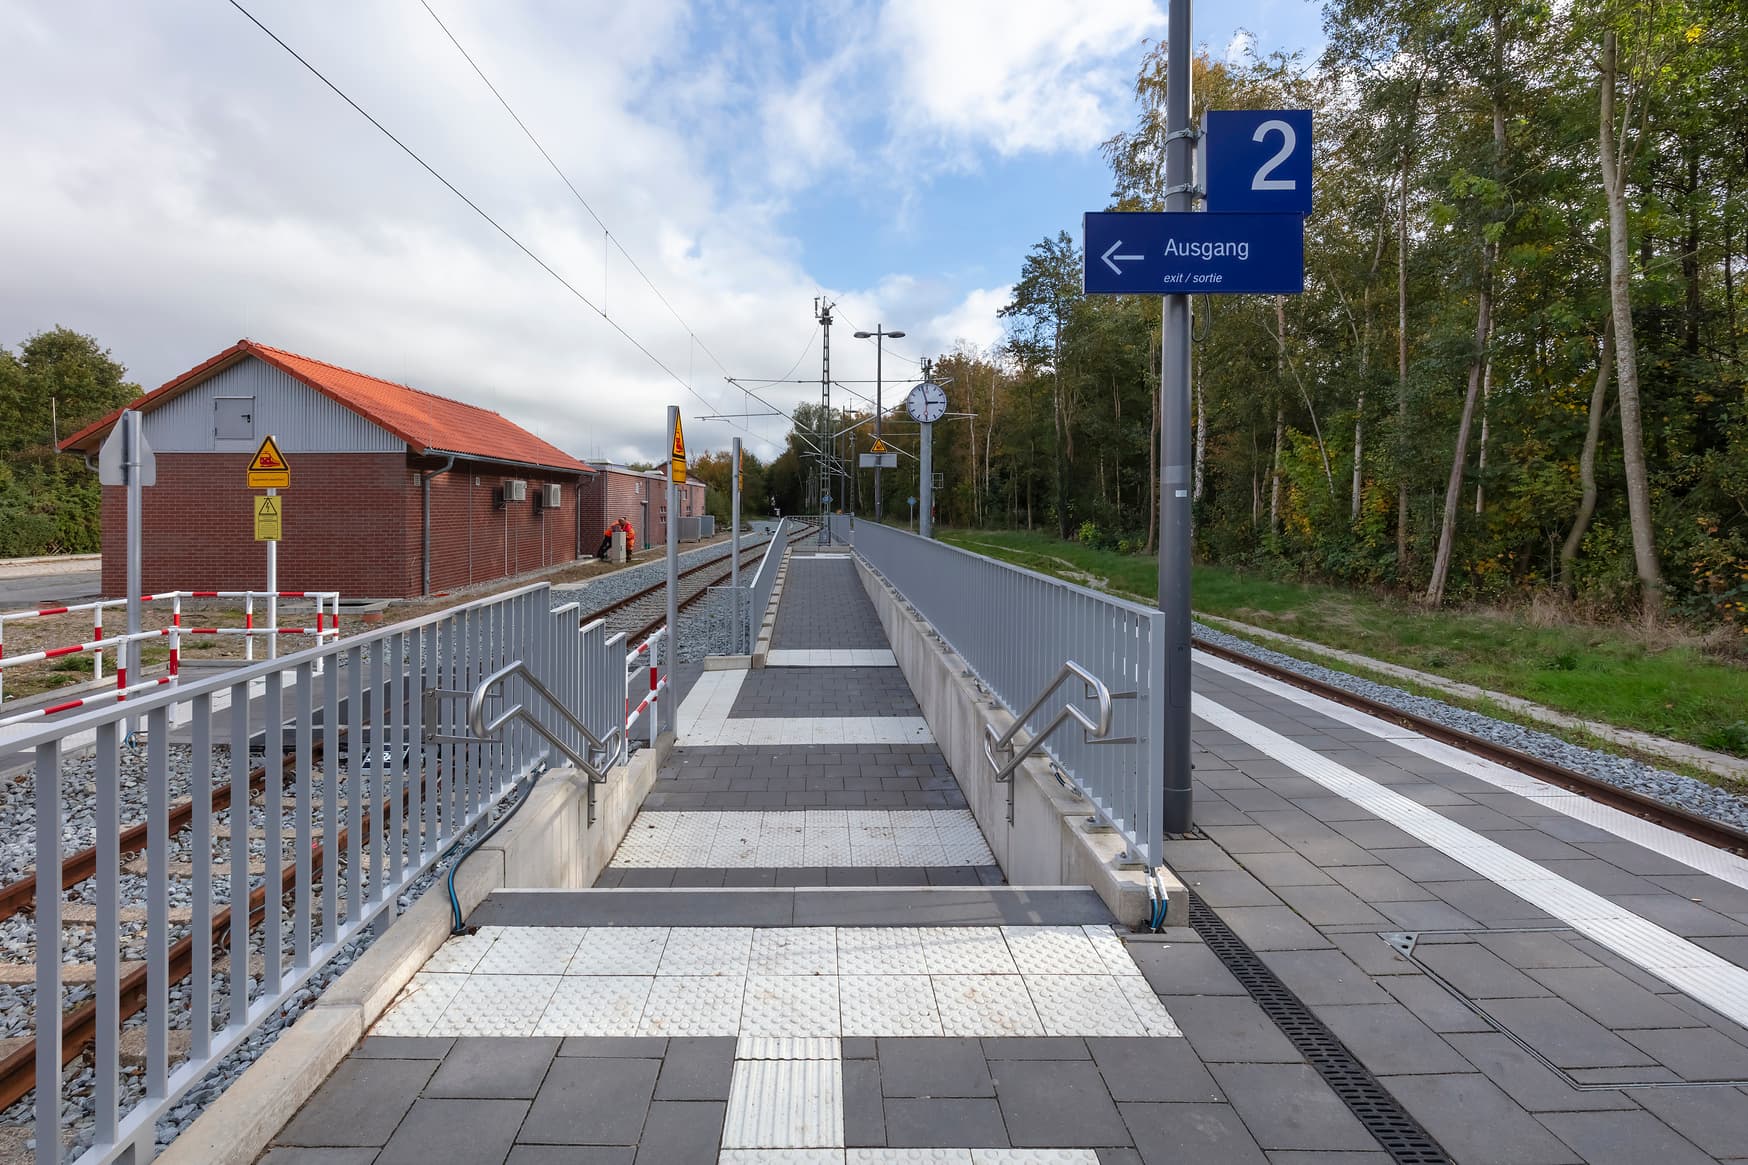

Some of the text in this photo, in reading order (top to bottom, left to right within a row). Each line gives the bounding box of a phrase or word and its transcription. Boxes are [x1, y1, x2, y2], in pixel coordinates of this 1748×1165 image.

[1251, 119, 1297, 191] 2
[1164, 238, 1249, 260] Ausgang
[1163, 273, 1223, 283] exit / sortie
